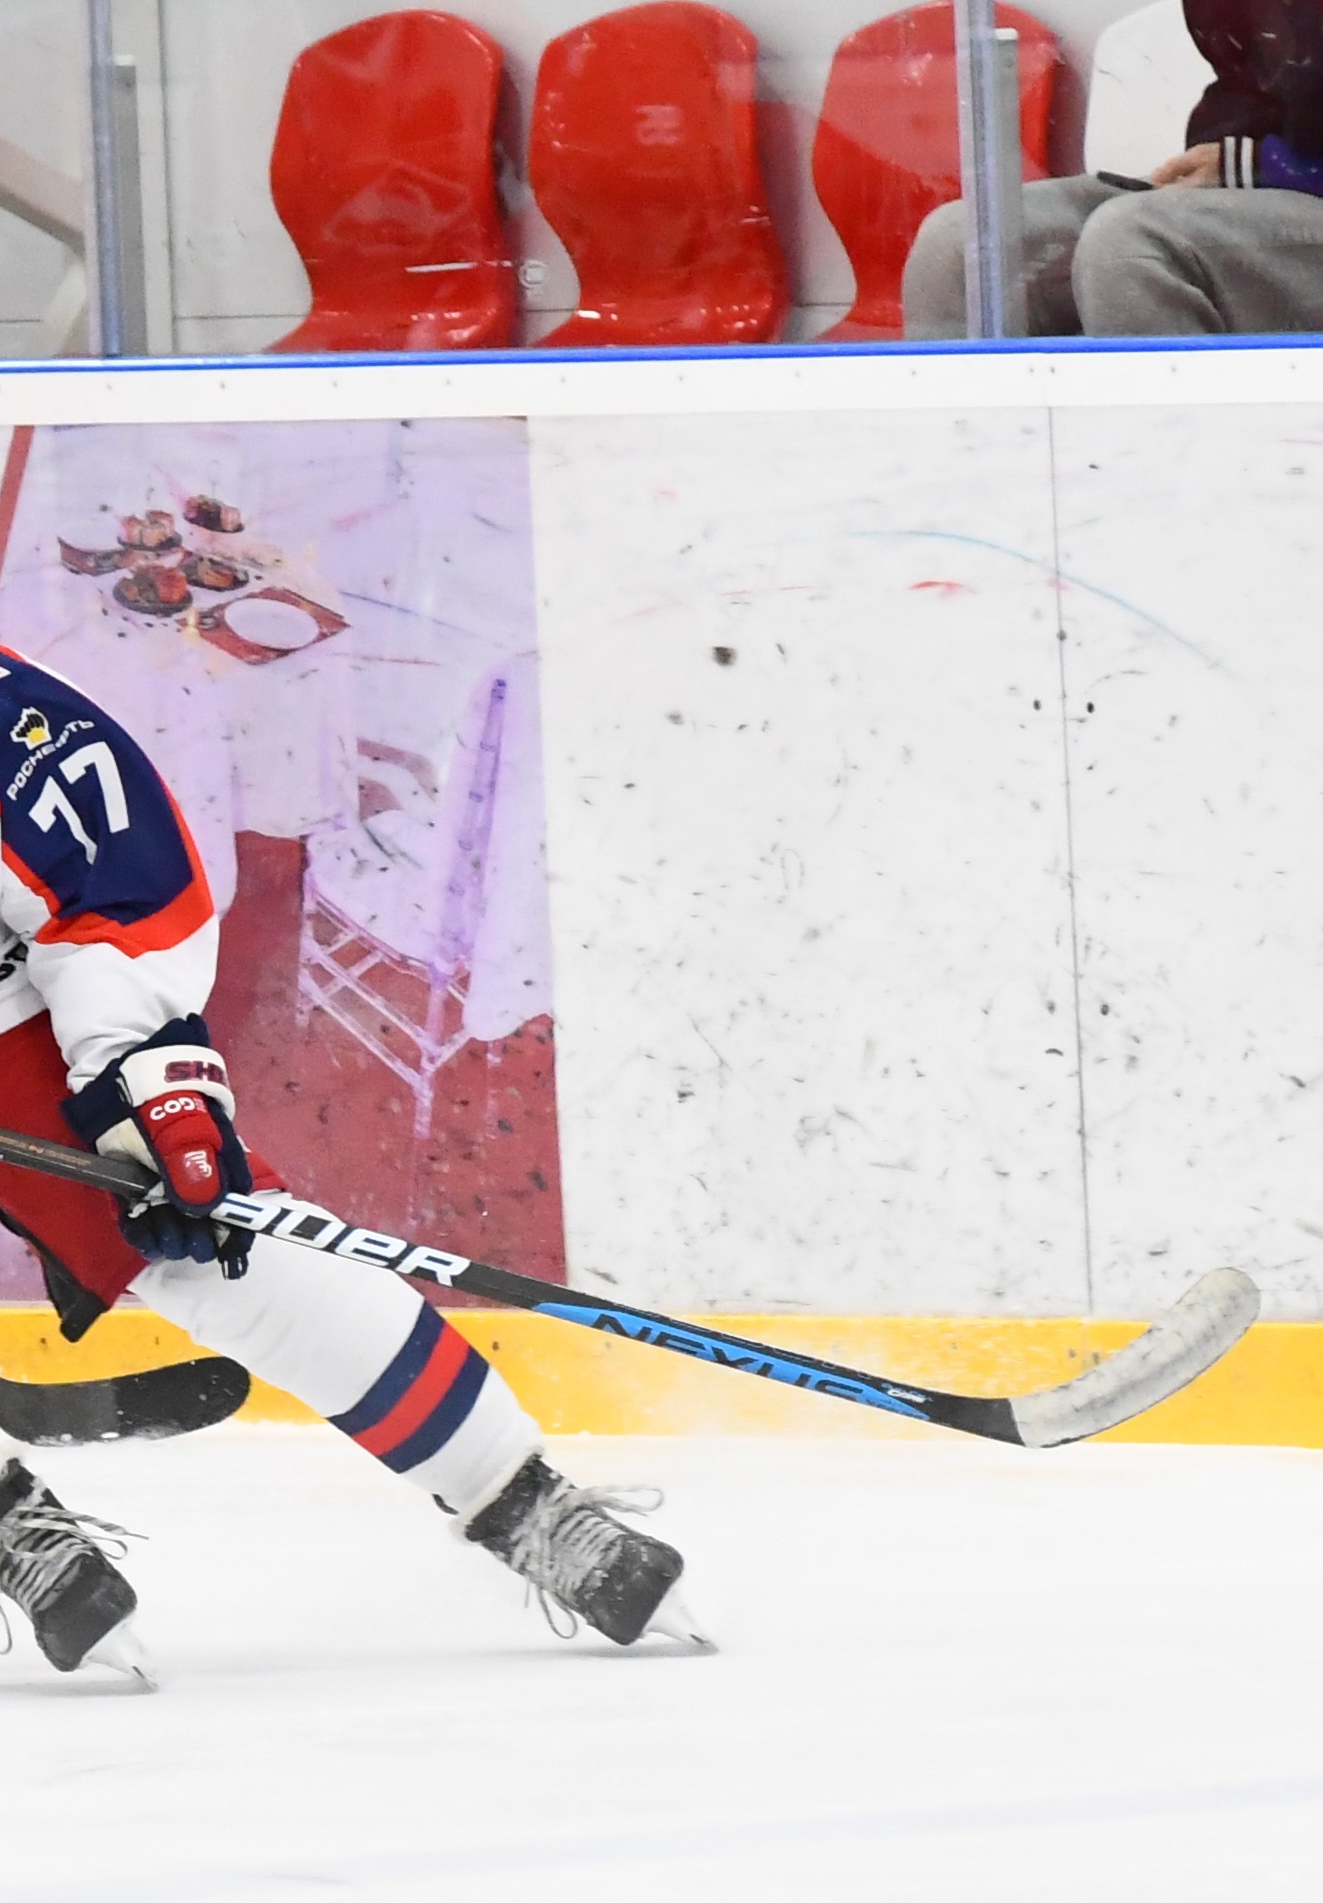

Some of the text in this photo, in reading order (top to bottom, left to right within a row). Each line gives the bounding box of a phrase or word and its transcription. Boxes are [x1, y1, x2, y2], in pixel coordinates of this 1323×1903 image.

[6, 717, 96, 801] РОСНЕФТЬ
[28, 740, 131, 866] 77
[209, 1192, 472, 1288] AUER
[591, 1313, 865, 1402] NEXUS
